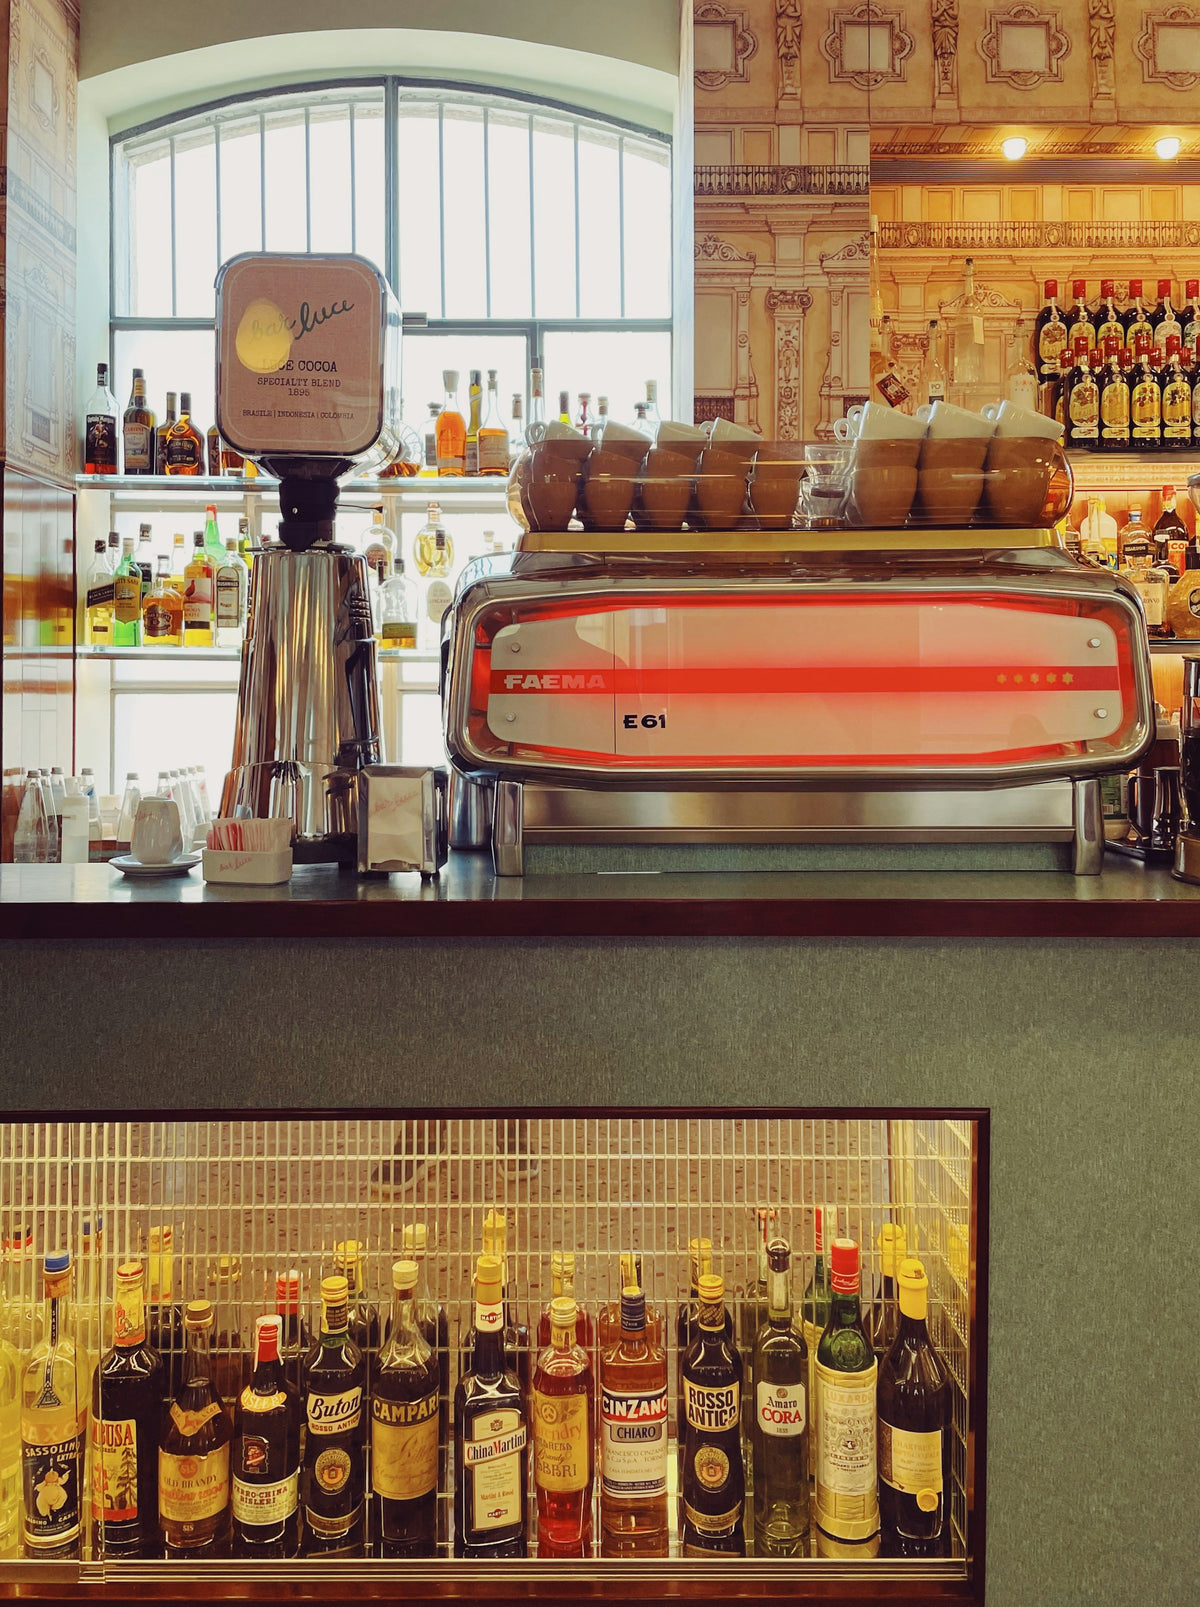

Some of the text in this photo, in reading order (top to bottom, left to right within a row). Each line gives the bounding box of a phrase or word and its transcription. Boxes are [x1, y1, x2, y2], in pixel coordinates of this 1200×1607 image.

[294, 299, 355, 340] luce
[298, 360, 338, 373] COCOA
[257, 377, 341, 388] SPECIALTY BLEND
[287, 388, 310, 397] 1895
[242, 409, 355, 420] BRASILE INDONESIA COLOMBIA
[504, 674, 606, 689] FAEMA
[688, 1386, 734, 1410] ROSSO
[766, 1396, 798, 1409] Amaro
[309, 1395, 360, 1420] Buton
[373, 1392, 439, 1422] CAMPARI
[602, 1394, 668, 1419] CINZANO
[688, 1405, 736, 1428] ANTICO
[761, 1407, 803, 1424] CORA
[311, 1422, 333, 1432] ROSSO
[617, 1427, 656, 1439] CHIARO
[164, 1474, 218, 1489] OLD BRANDY
[240, 1495, 276, 1505] BISLERI
